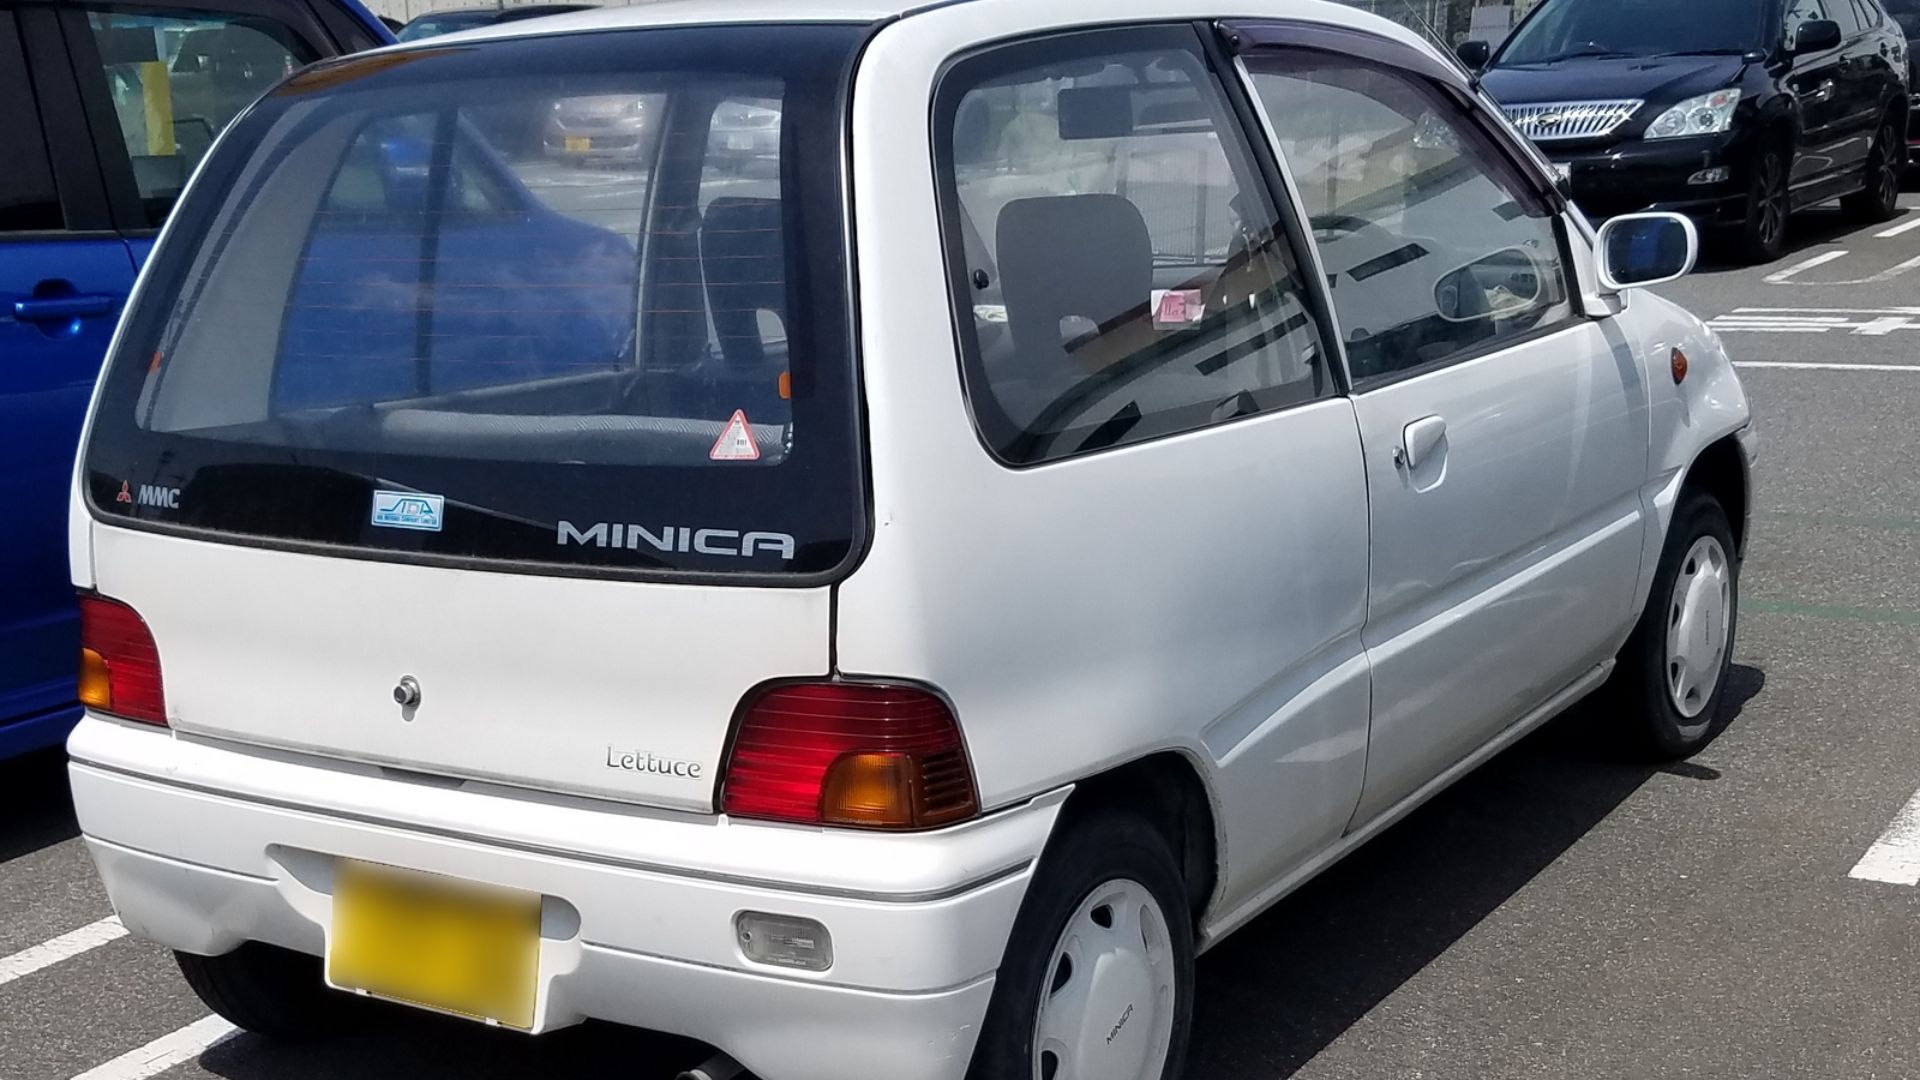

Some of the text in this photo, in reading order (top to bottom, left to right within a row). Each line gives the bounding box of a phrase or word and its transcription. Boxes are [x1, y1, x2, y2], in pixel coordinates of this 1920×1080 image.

[138, 484, 181, 509] MMC
[556, 520, 796, 560] MINICA
[606, 745, 701, 779] Lettuce
[1106, 1003, 1134, 1045] MINICA
